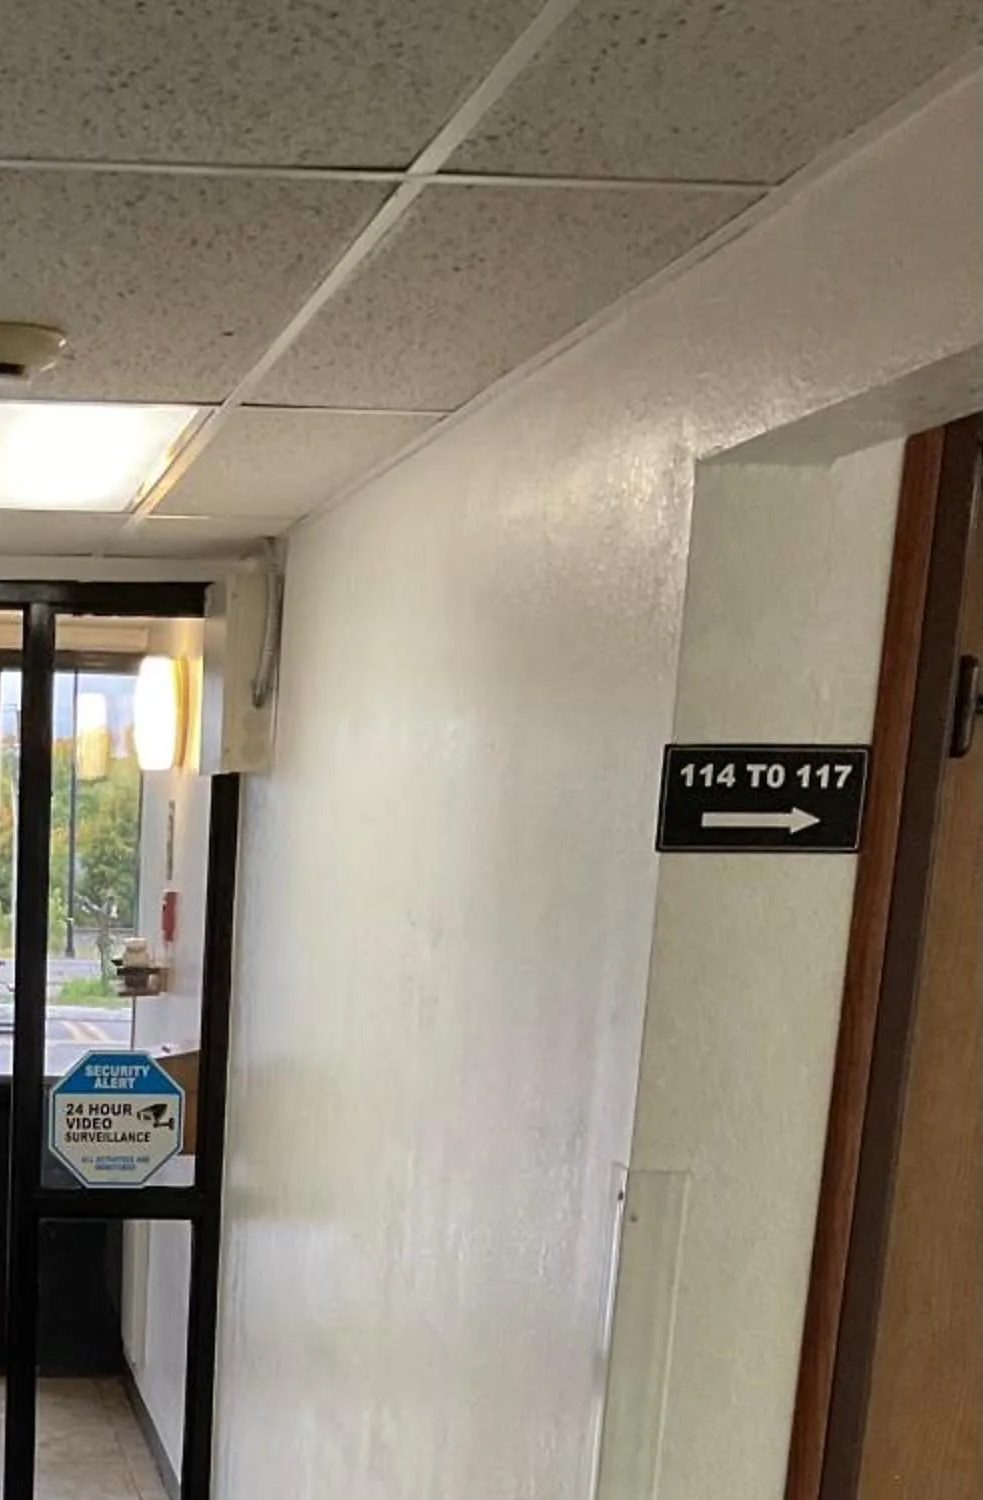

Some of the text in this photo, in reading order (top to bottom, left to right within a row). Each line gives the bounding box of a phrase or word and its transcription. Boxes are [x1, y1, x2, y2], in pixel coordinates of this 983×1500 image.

[680, 763, 853, 789] 114 TO 117
[84, 1065, 150, 1077] SECURITY
[93, 1078, 136, 1089] ALERT
[66, 1103, 132, 1116] 24 HOUR
[66, 1117, 113, 1129] VIDEO
[64, 1131, 151, 1143] SURVEILLANCE
